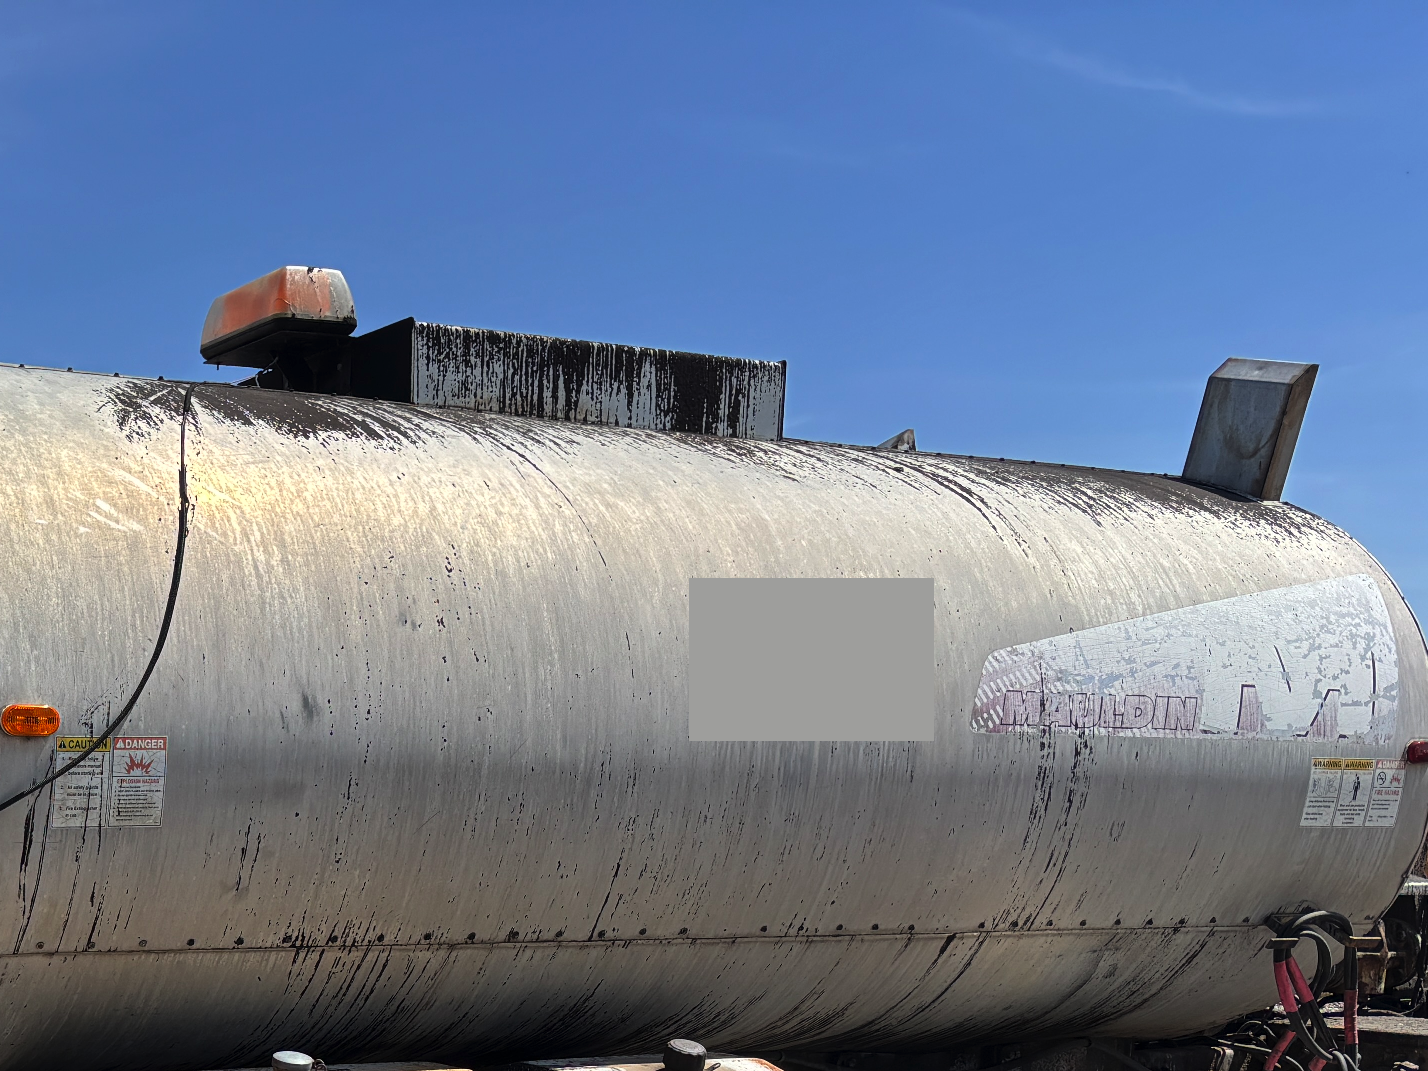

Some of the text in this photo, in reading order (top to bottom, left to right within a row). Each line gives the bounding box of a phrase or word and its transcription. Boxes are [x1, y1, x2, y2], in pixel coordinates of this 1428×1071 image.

[1000, 689, 1198, 731] MAULDIN
[68, 739, 108, 749] CAUTN
[125, 739, 164, 749] DANGER
[1317, 760, 1342, 768] WARNING
[1350, 760, 1374, 768] WARNING
